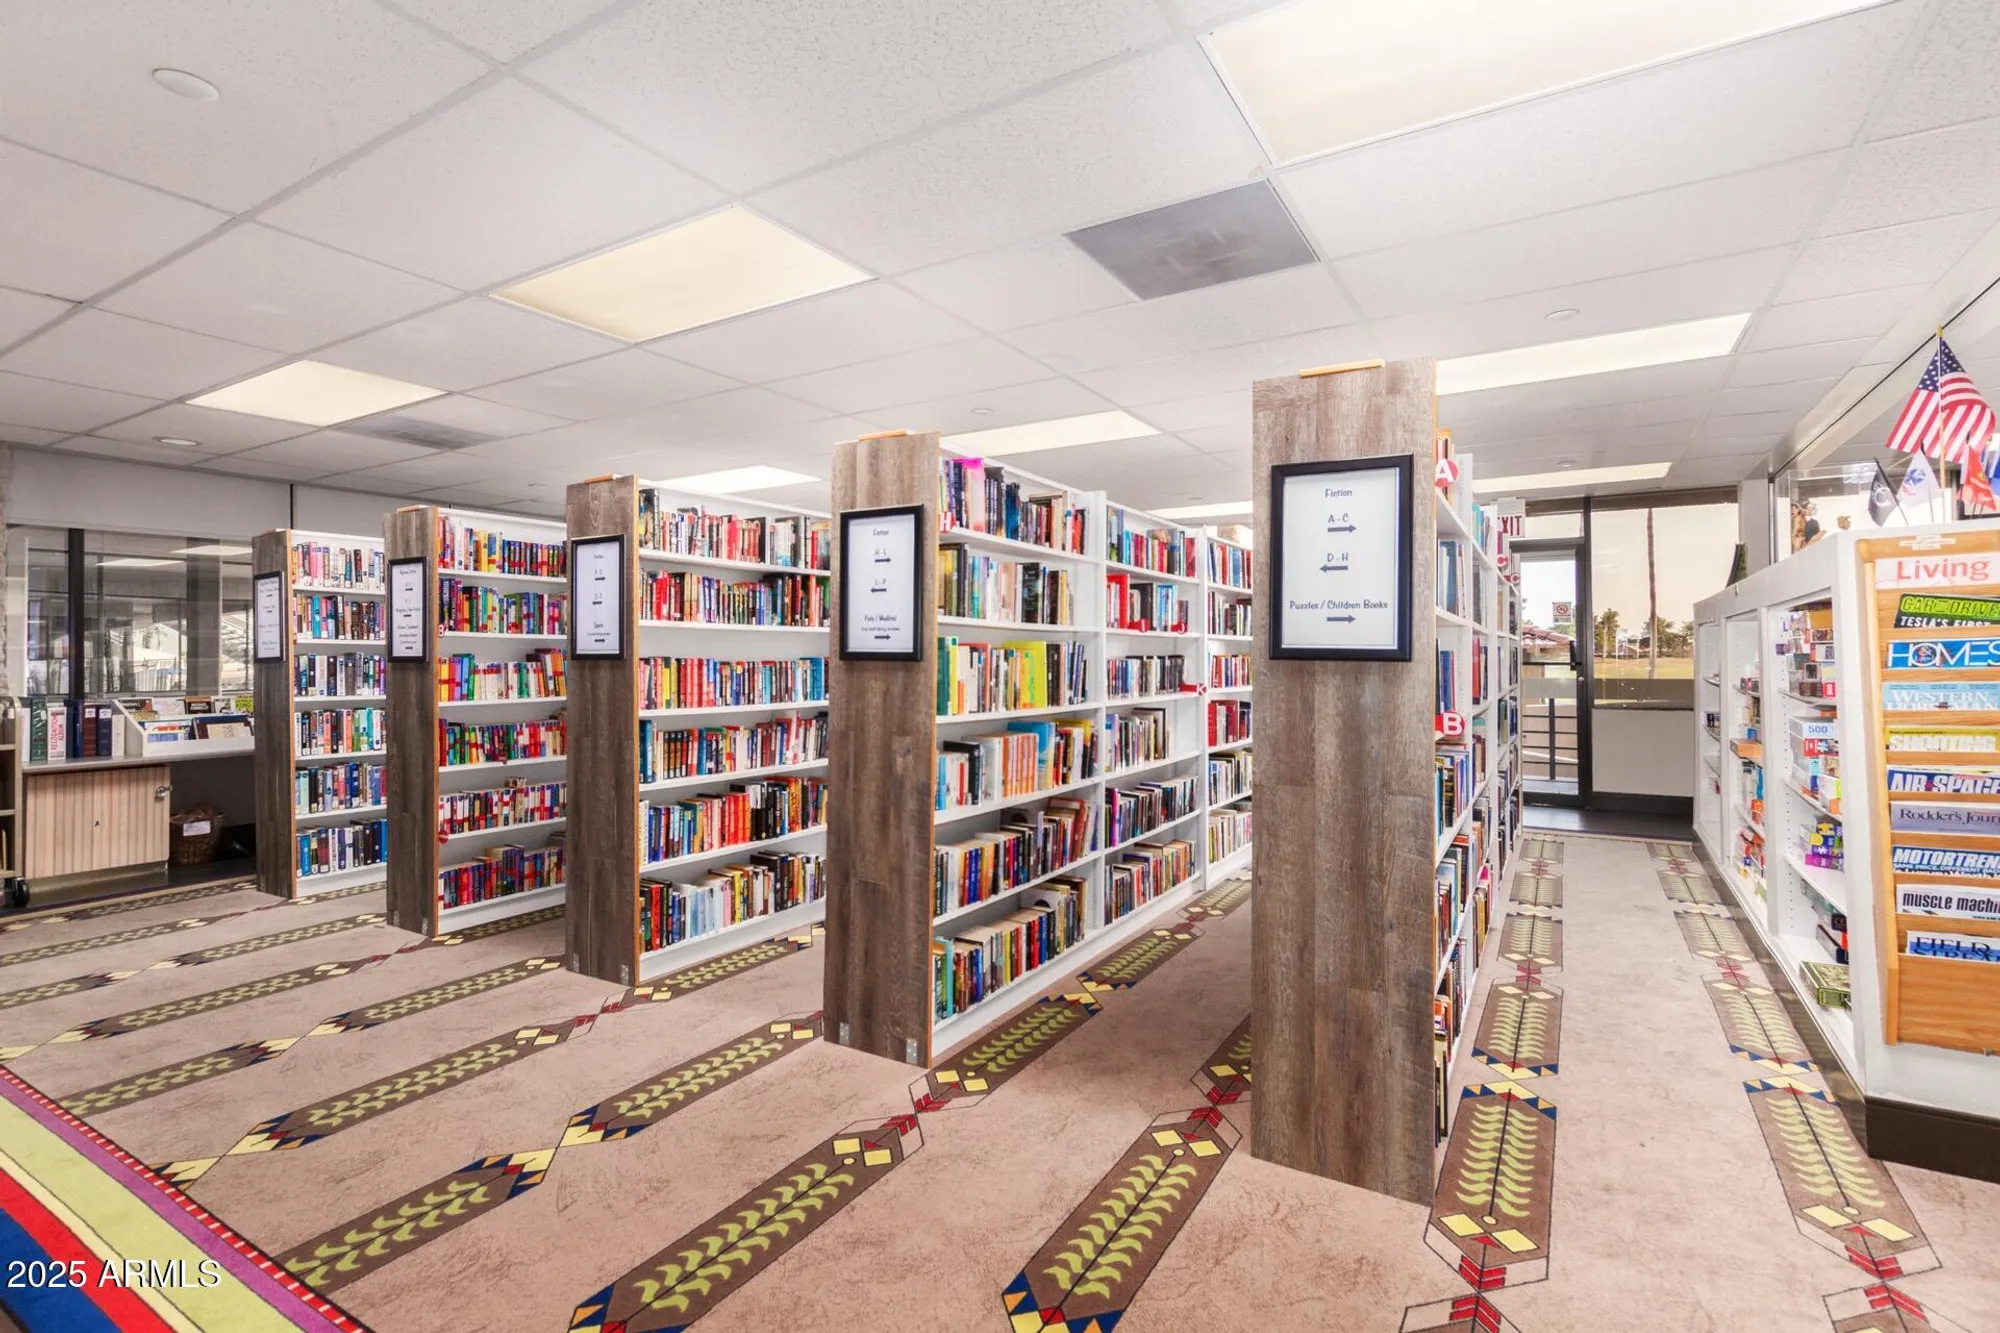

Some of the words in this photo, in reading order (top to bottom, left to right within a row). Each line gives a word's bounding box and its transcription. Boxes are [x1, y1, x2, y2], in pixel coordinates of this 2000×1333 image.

[1436, 459, 1454, 482] A
[1325, 488, 1353, 498] Fiction
[1327, 514, 1335, 523] A
[1342, 513, 1349, 523] C
[1497, 515, 1522, 536] XIT
[1327, 553, 1335, 562] D
[1341, 553, 1349, 561] H
[1896, 559, 1990, 581] Living
[1289, 600, 1319, 610] Puzzles
[1326, 600, 1361, 610] Children
[1363, 599, 1388, 609] Books
[1901, 596, 1935, 613] CAR
[1900, 616, 1949, 628] TESLA'S
[1443, 712, 1463, 736] B
[1808, 725, 1828, 734] 500
[1890, 772, 1927, 792] AIR
[1900, 809, 1962, 821] Rodder's
